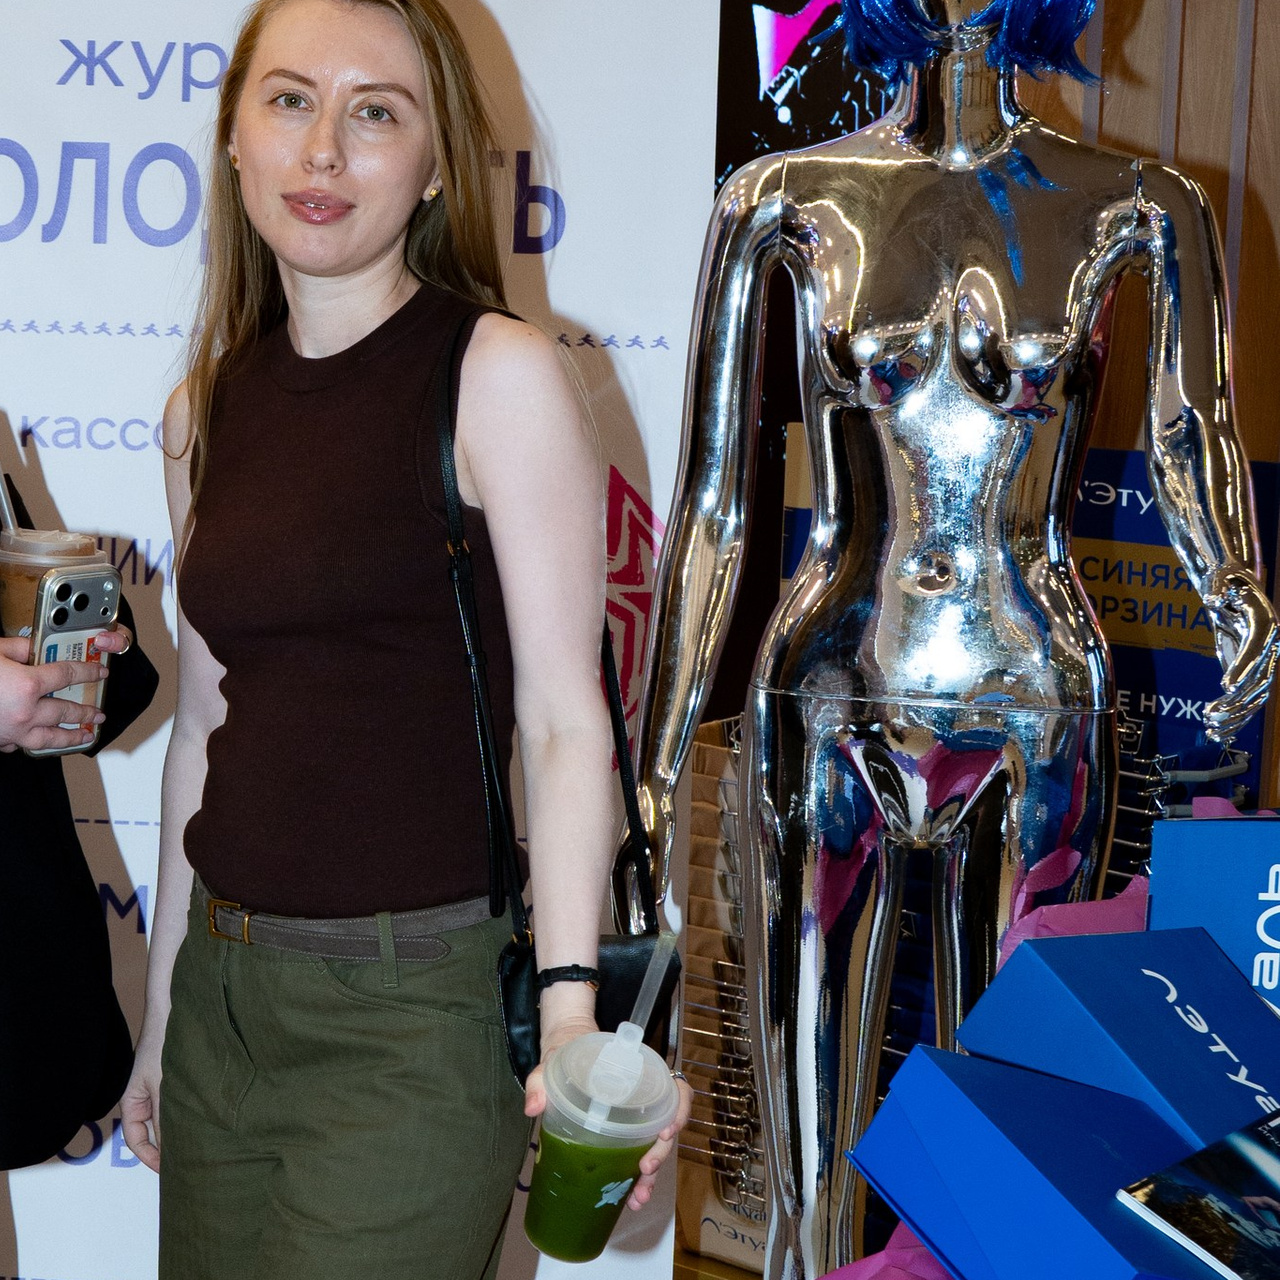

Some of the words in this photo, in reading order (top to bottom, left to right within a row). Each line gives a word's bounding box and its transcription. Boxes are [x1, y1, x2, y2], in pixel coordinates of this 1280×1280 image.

[56, 38, 230, 103] жур
[20, 415, 163, 451] касс
[1080, 556, 1193, 593] СИНЯЯ
[1140, 694, 1205, 721] НУЖ
